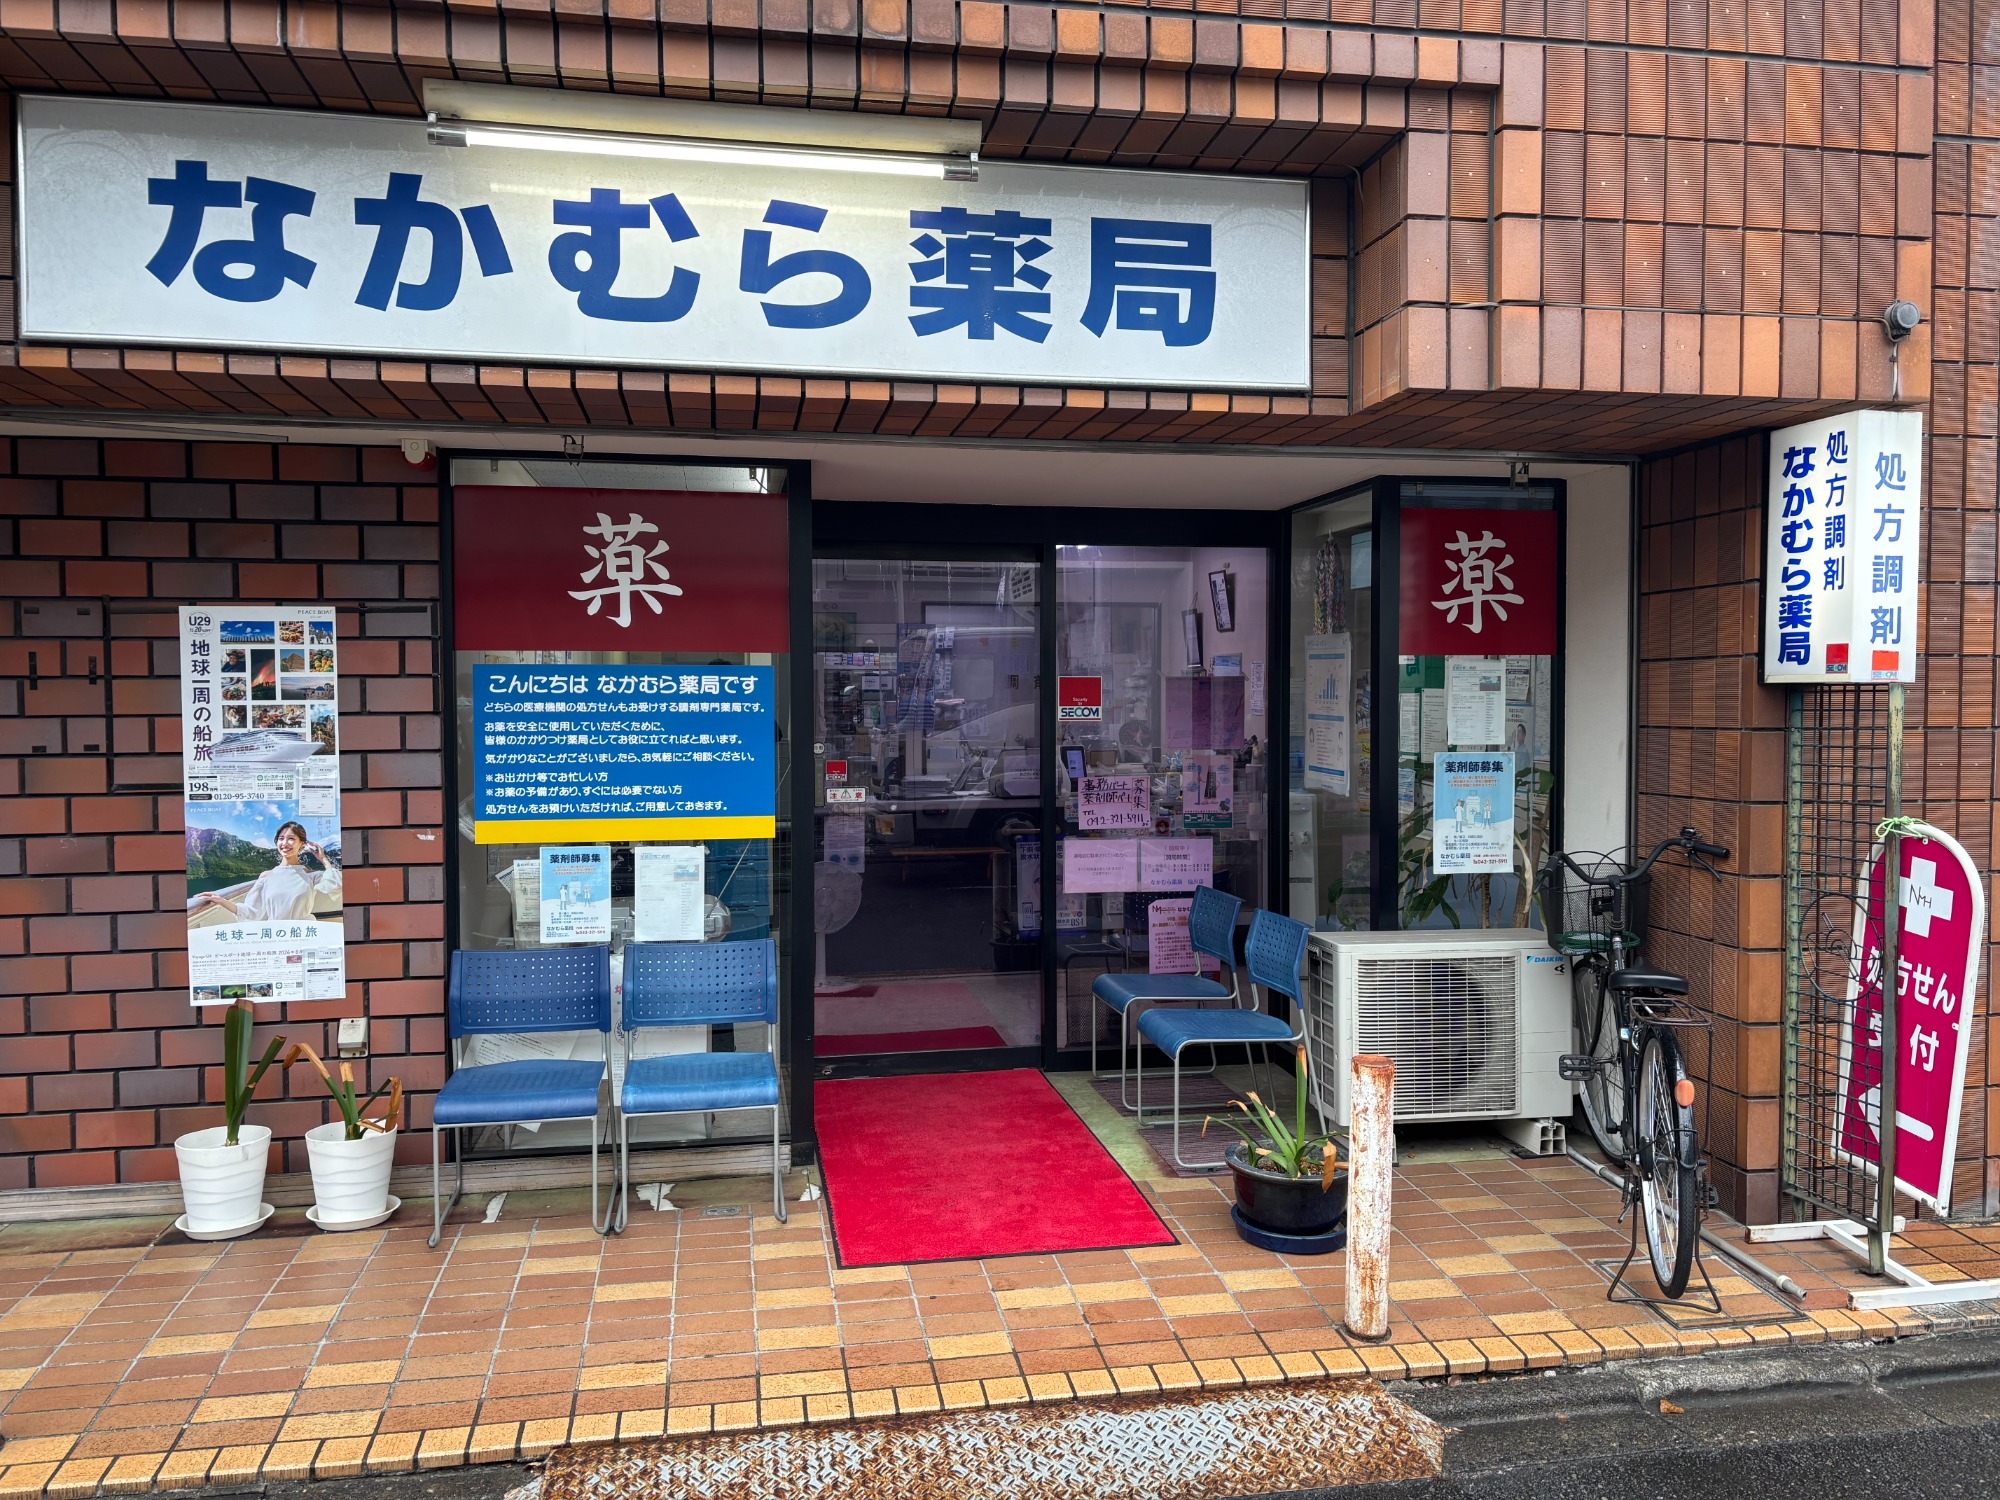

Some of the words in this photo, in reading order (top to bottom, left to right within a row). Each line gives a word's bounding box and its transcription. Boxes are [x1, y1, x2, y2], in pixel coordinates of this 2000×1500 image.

[145, 160, 1217, 347] なかむら薬局
[1823, 430, 1848, 592] 処方調剤
[1870, 452, 1907, 645] 処方調剤
[1778, 446, 1816, 666] なかむら薬局
[568, 512, 684, 629] 薬
[1431, 530, 1525, 634] 薬
[188, 616, 211, 626] U29
[1826, 664, 1847, 672] SECOM
[489, 674, 589, 694] こんにちは
[597, 674, 759, 695] なかむら薬局です
[190, 640, 213, 762] 地球一周の船旅
[484, 702, 766, 713] どちらの医療機関の処方せんもお受けする調剤専門薬局です。
[1060, 707, 1100, 717] SECOM
[484, 721, 666, 732] お薬を安全に使用していただくために、
[485, 734, 743, 745] 皆様のかかりつけ薬局としてお役に立てればと思います。
[485, 752, 756, 764] 気がかりなことがございましたら、お気軽にご相談ください。
[1444, 760, 1504, 773] 薬剤師募集
[485, 801, 728, 815] 処方せんをお預けいただければ、ご用意しておきます。
[549, 854, 602, 864] 薬剤師募集
[215, 926, 318, 941] 地球一周の船旅
